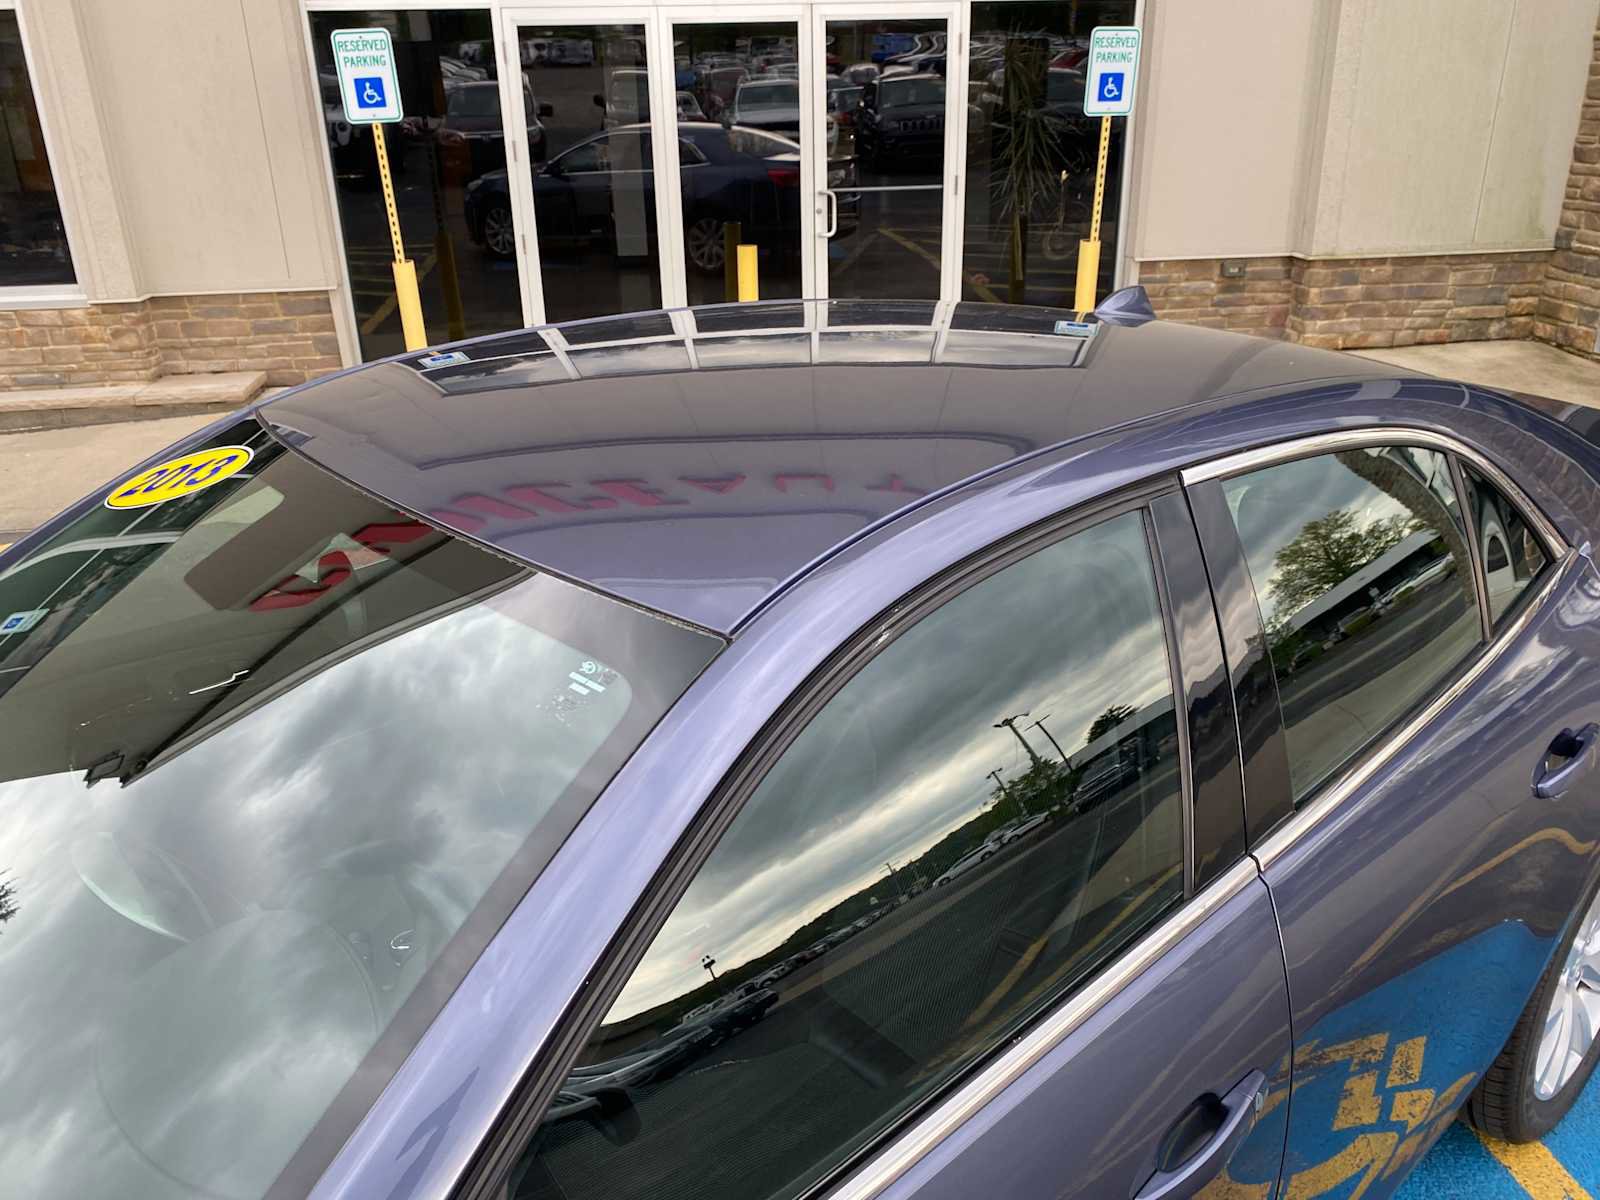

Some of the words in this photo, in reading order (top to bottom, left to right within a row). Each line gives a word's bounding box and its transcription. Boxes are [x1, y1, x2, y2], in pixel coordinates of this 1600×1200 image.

[337, 39, 387, 52] RESERVED
[1095, 36, 1137, 48] RESERVED
[343, 55, 386, 68] PARKING
[1096, 52, 1133, 63] PARKING
[115, 454, 239, 498] 2013
